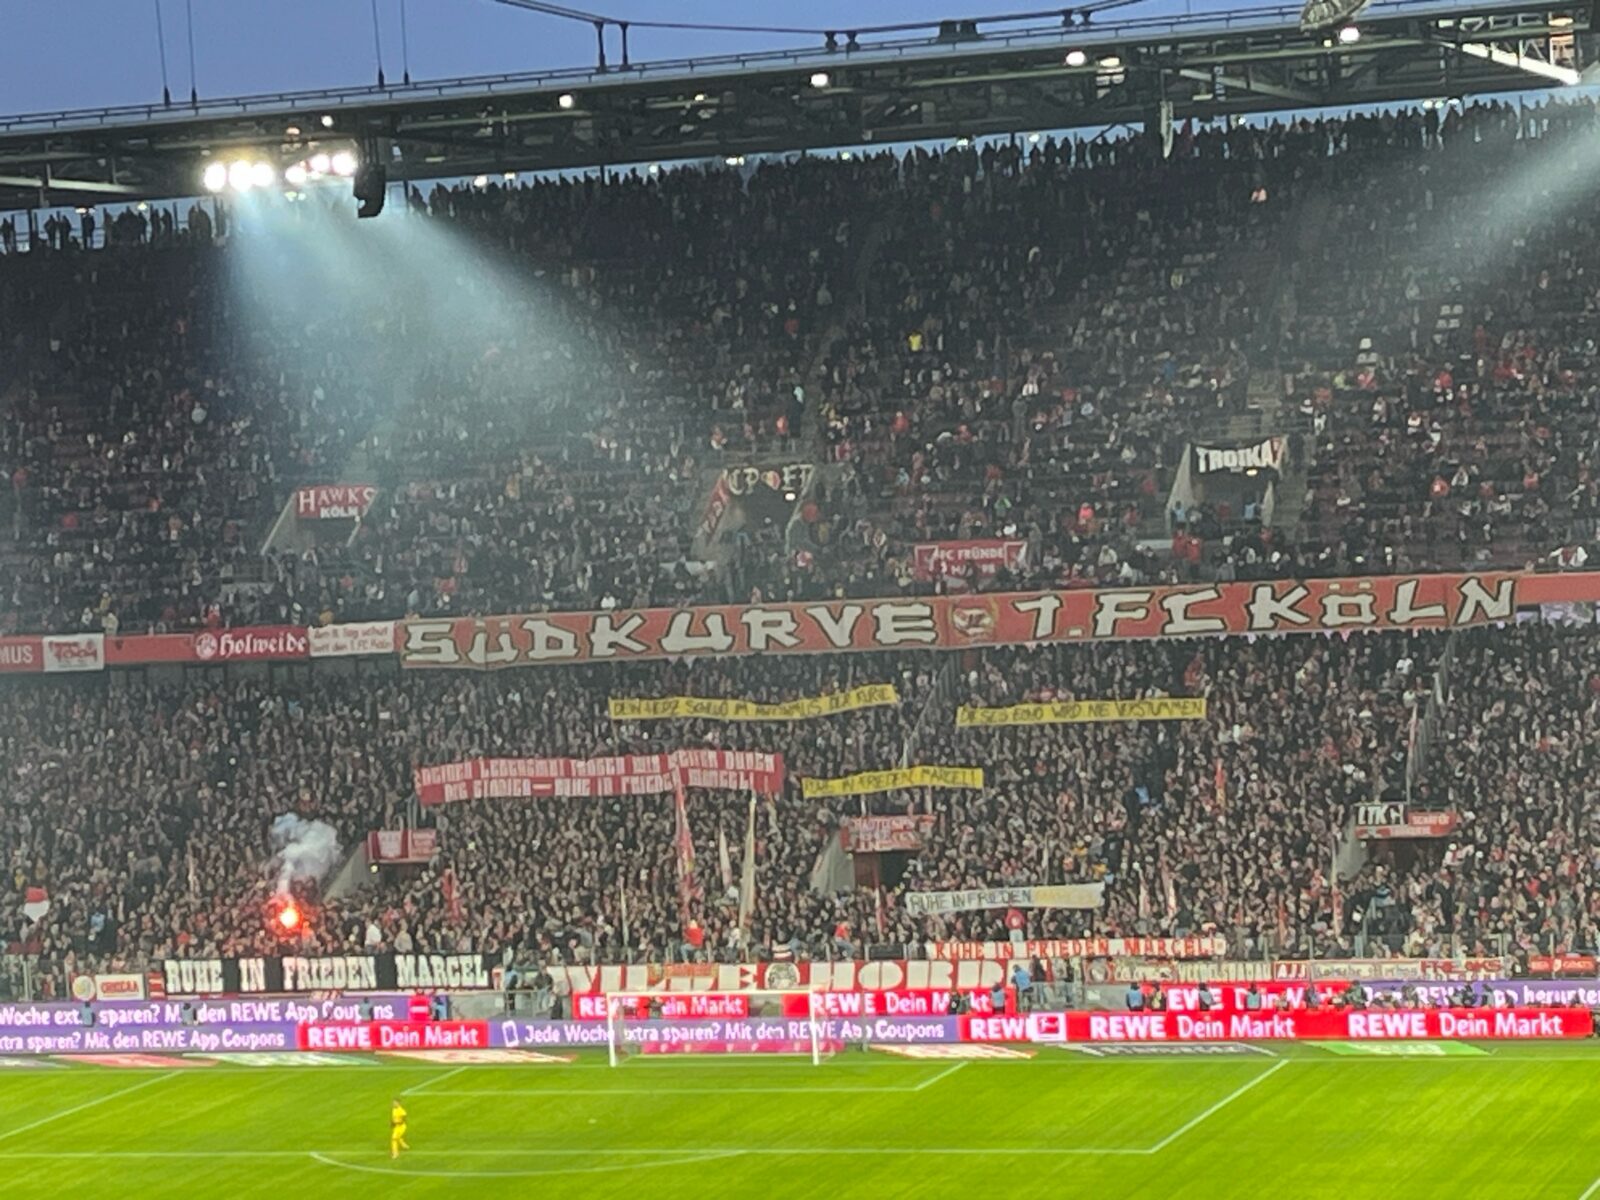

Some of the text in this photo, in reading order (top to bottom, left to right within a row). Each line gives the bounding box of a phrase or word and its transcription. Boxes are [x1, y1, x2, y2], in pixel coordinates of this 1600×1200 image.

[299, 486, 376, 513] HAWKS
[1247, 576, 1518, 627] KÖLN
[219, 633, 306, 657] Holweide
[404, 601, 937, 664] SÜDKURVE
[1025, 940, 1109, 959] FRIEDEN
[164, 953, 489, 993] RUHE IN FRIEDEN MARCEL
[99, 1004, 159, 1028] sparen?
[198, 1003, 227, 1023] den
[230, 1002, 282, 1022] REWE
[285, 1000, 319, 1023] App
[690, 994, 744, 1016] Markt
[811, 989, 991, 1015] REWE Dein Mkt
[308, 1024, 478, 1048] REWE Dein Markt
[525, 1025, 560, 1043] Jede
[563, 1022, 614, 1042] Woche
[661, 1022, 721, 1043] sparen?
[725, 1022, 752, 1041] Mit
[756, 1022, 785, 1040] den
[788, 1020, 837, 1039] REWE
[875, 1018, 945, 1042] Coupons
[1089, 1012, 1296, 1038] REWE Dein Markt
[1348, 1010, 1564, 1037] REWE Dein Markt
[26, 1032, 82, 1053] sparen?
[84, 1031, 110, 1049] Mit
[112, 1031, 140, 1048] den
[142, 1029, 187, 1048] REWE
[189, 1027, 219, 1051] App
[221, 1028, 285, 1051] Coupons
